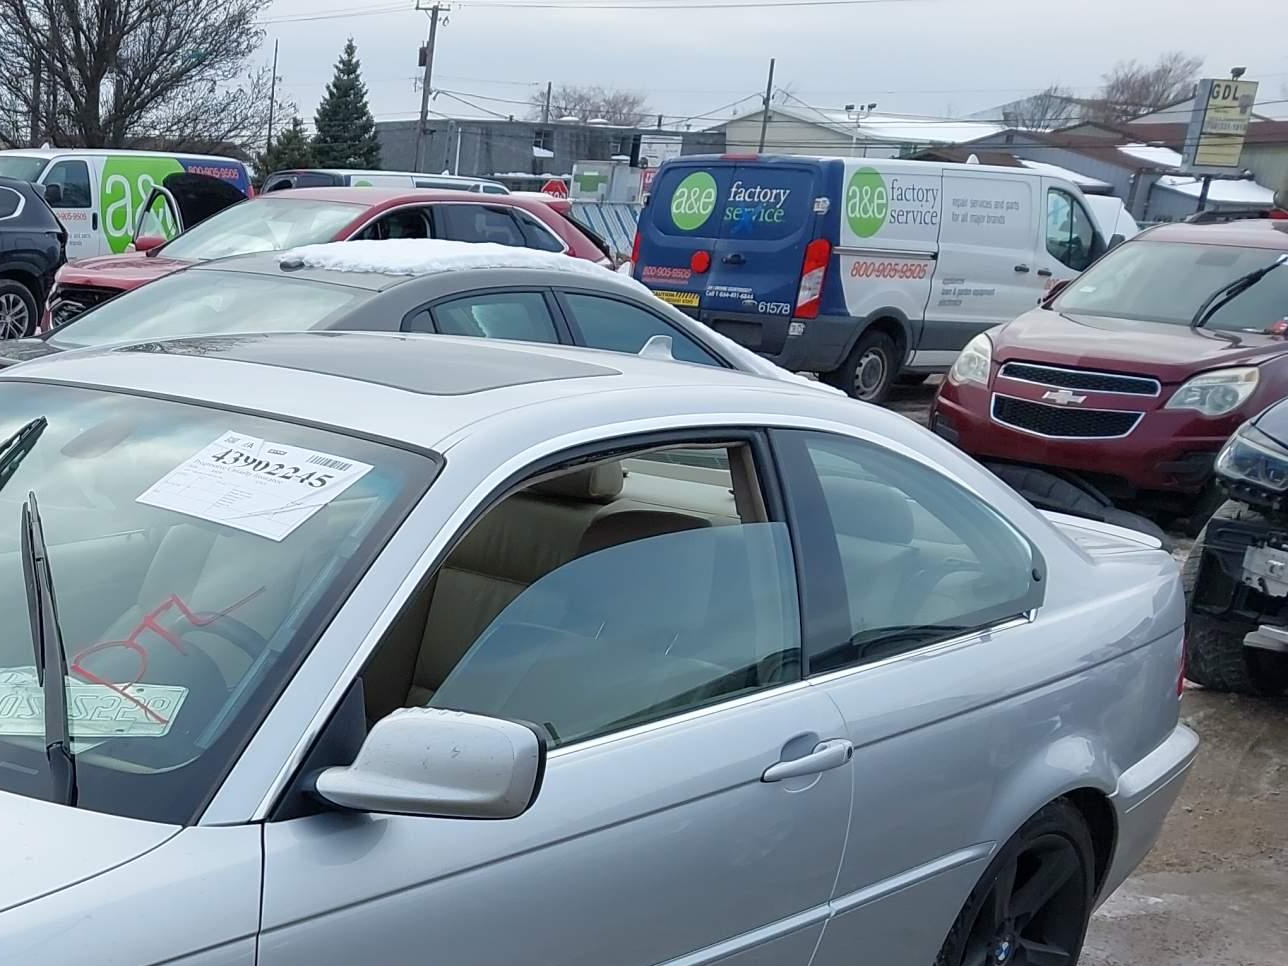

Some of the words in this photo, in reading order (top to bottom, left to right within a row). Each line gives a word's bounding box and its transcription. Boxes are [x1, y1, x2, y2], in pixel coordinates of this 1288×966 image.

[1211, 84, 1239, 101] GDL
[672, 187, 715, 214] a&e
[728, 181, 791, 208] factory
[848, 185, 887, 219] a&e
[890, 179, 939, 210] factory
[889, 204, 938, 225] service
[850, 261, 928, 279] 800-905-9505
[758, 302, 790, 314] 61578
[211, 448, 335, 488] 43902245
